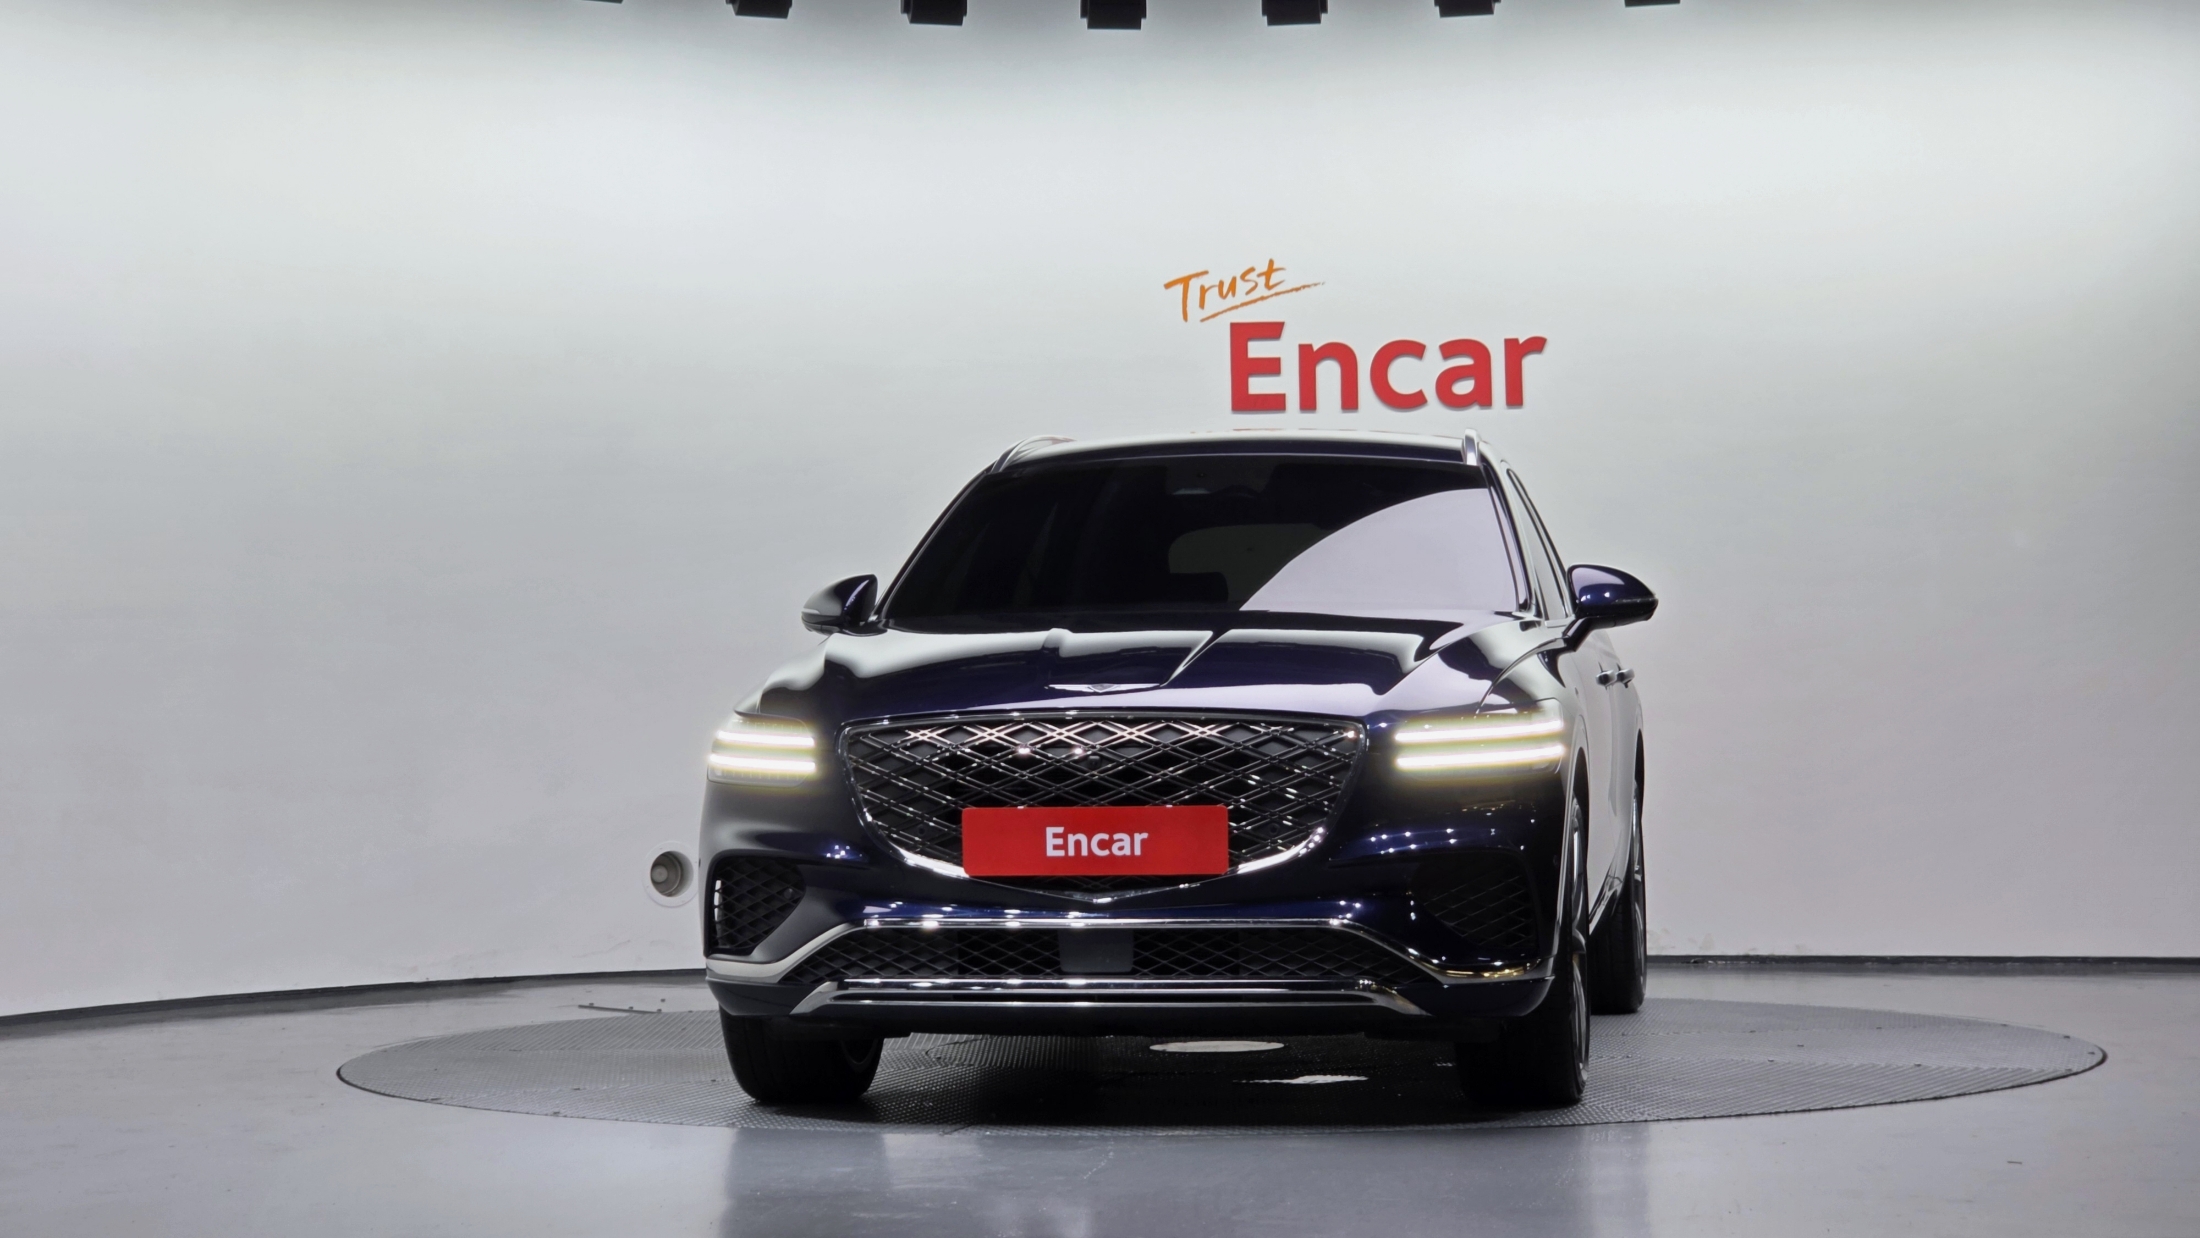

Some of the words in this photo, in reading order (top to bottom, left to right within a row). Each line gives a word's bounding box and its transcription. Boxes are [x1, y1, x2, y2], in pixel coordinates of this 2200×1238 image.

[1163, 258, 1287, 323] Trust
[1230, 321, 1548, 414] Encar
[1045, 826, 1149, 857] Encar
